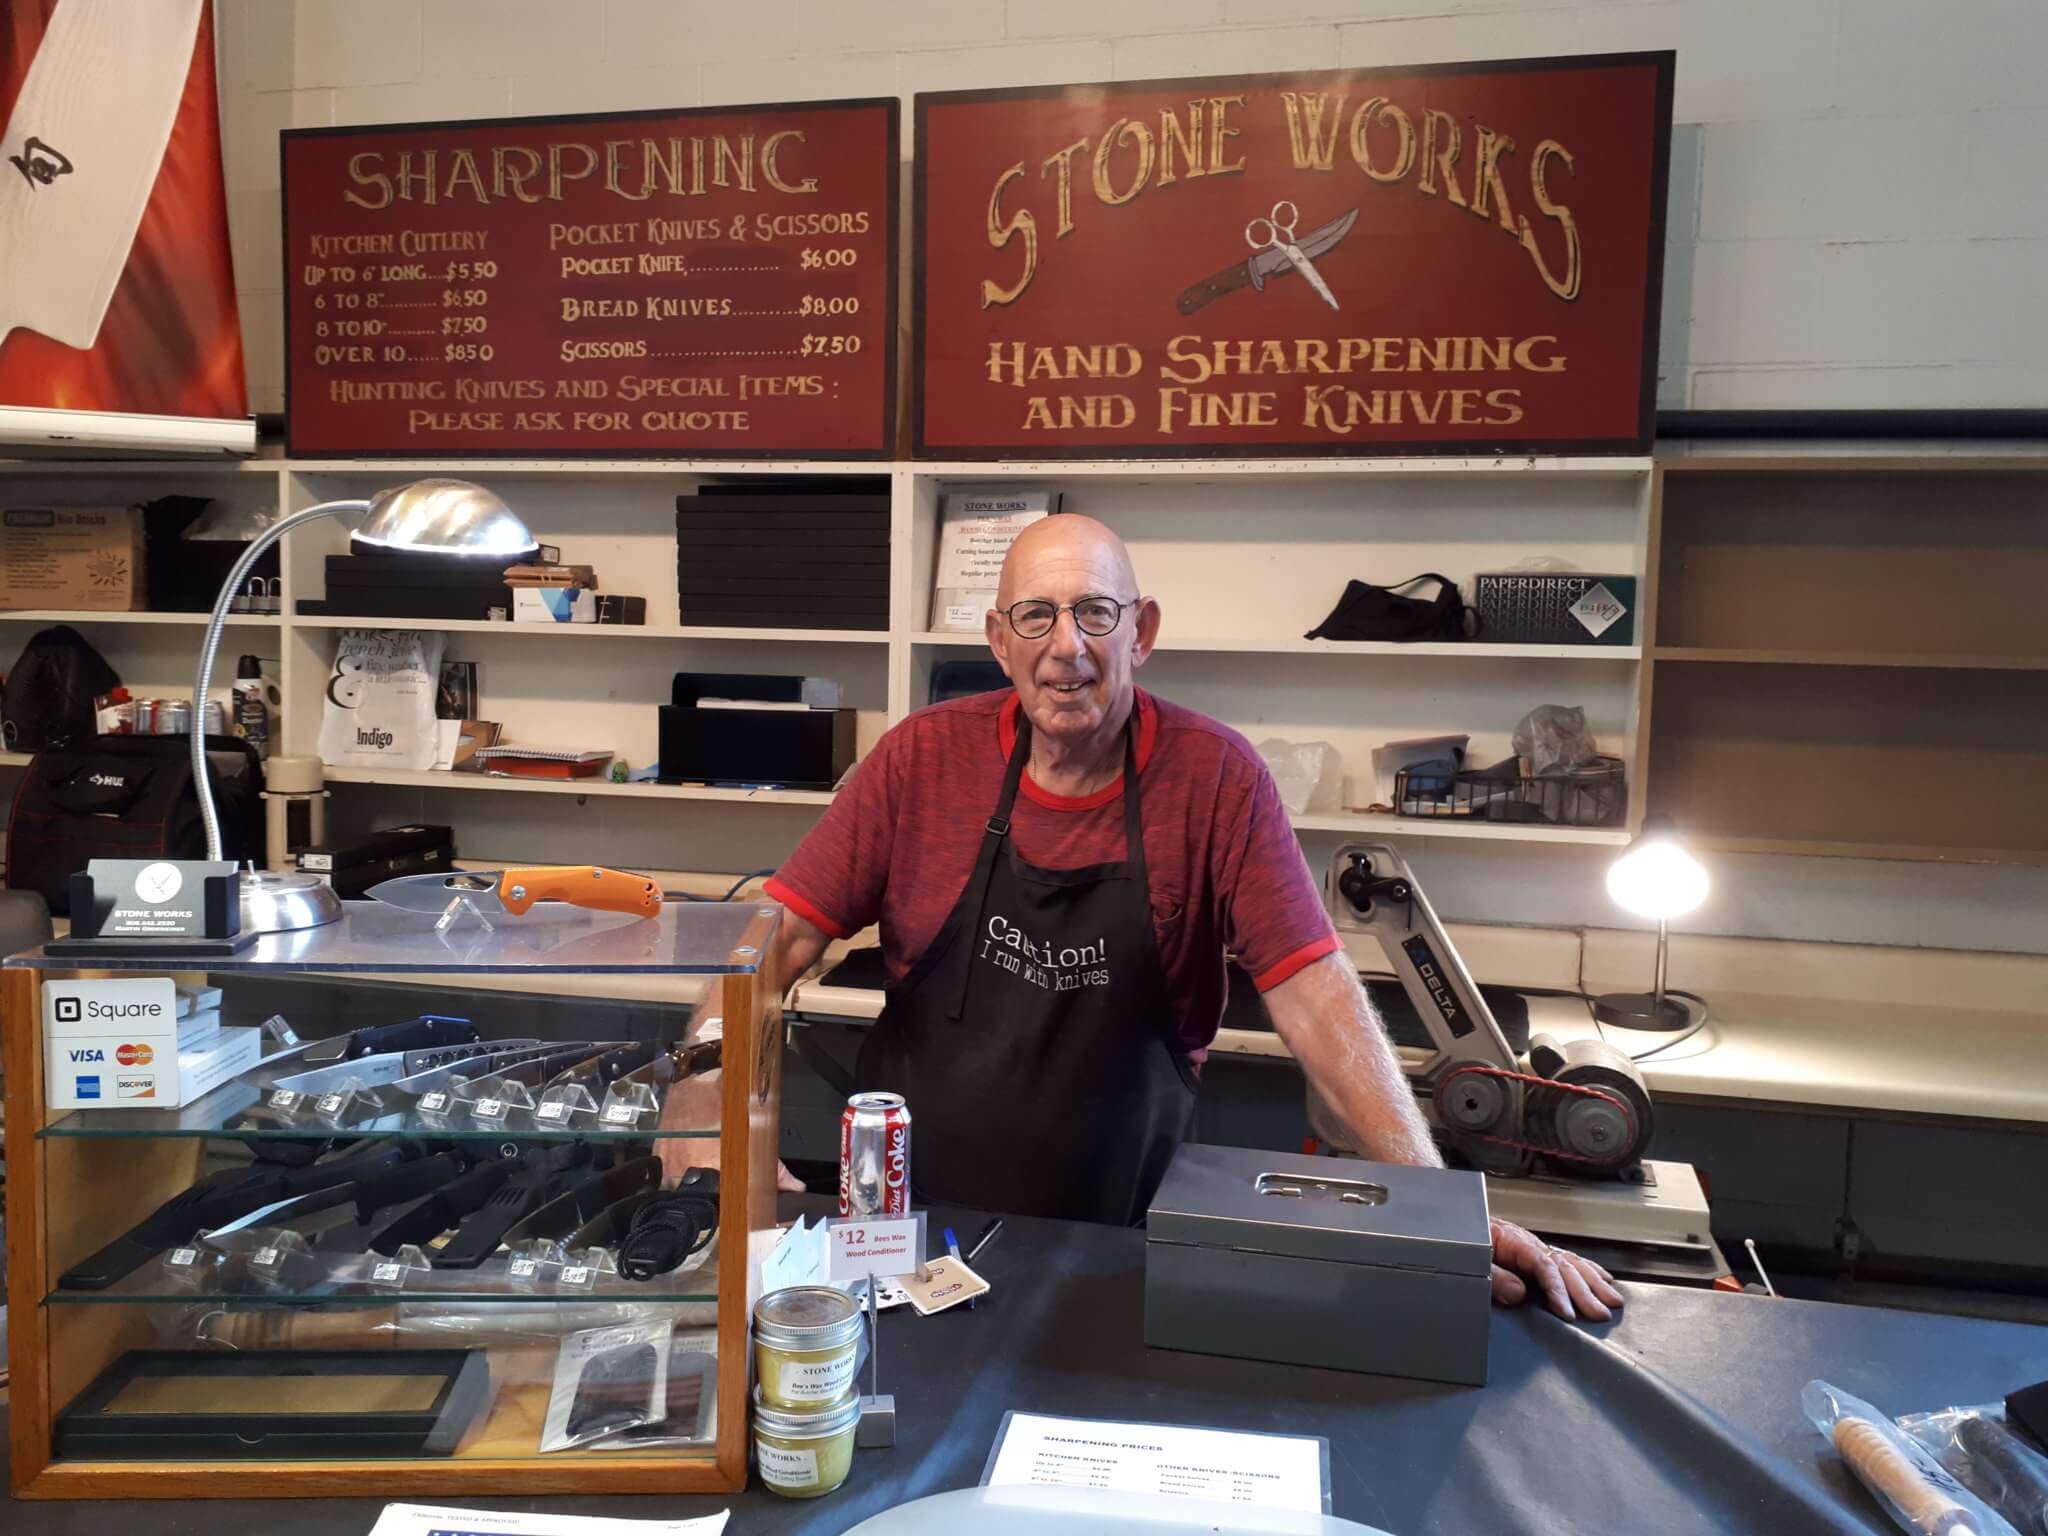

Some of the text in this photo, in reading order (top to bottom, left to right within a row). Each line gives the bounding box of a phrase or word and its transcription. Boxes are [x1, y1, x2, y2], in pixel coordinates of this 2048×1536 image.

[344, 130, 819, 209] SHARPENING
[981, 91, 1581, 310] STONE WORKS
[549, 211, 869, 249] POCKET KNIVES & SCISSORS
[312, 230, 488, 258] KITCHEN CUTLERY
[304, 266, 326, 286] UP
[330, 267, 356, 282] TO
[561, 256, 633, 278] POCKET
[801, 249, 857, 271] $6.00
[314, 294, 325, 308] 6
[336, 294, 360, 308] TO
[561, 297, 639, 322] BREAD
[800, 295, 859, 317] $8.00
[316, 322, 329, 337] 8
[336, 321, 360, 337] TO
[315, 345, 375, 365] OVER
[560, 334, 861, 363] SCISSORS $7.50
[985, 334, 1567, 387] HAND SHARPENING
[330, 380, 446, 403] HUNTING
[455, 378, 545, 403] KNIVES
[555, 380, 608, 398] AND
[617, 375, 730, 401] SPECIAL
[409, 409, 749, 434] PLEASE ASK FOR QUOTE
[1022, 384, 1524, 433] AND FINE KNIVES
[964, 502, 1027, 511] STONE WORKS
[1481, 578, 1592, 589] PAPERDIRECT
[114, 910, 192, 918] STONE WORKS
[980, 940, 1109, 991] I run with knives
[1420, 963, 1456, 1019] DELTA
[87, 1000, 161, 1021] Square
[69, 1049, 105, 1062] VISA
[886, 1127, 906, 1188] Coke
[839, 1156, 850, 1214] Coke
[874, 1234, 891, 1243] Bees
[892, 1233, 907, 1242] Wax
[846, 1246, 907, 1259] Wood Conditioner
[802, 1366, 832, 1376] STONE
[1043, 1435, 1163, 1452] SHARPENING PRICES
